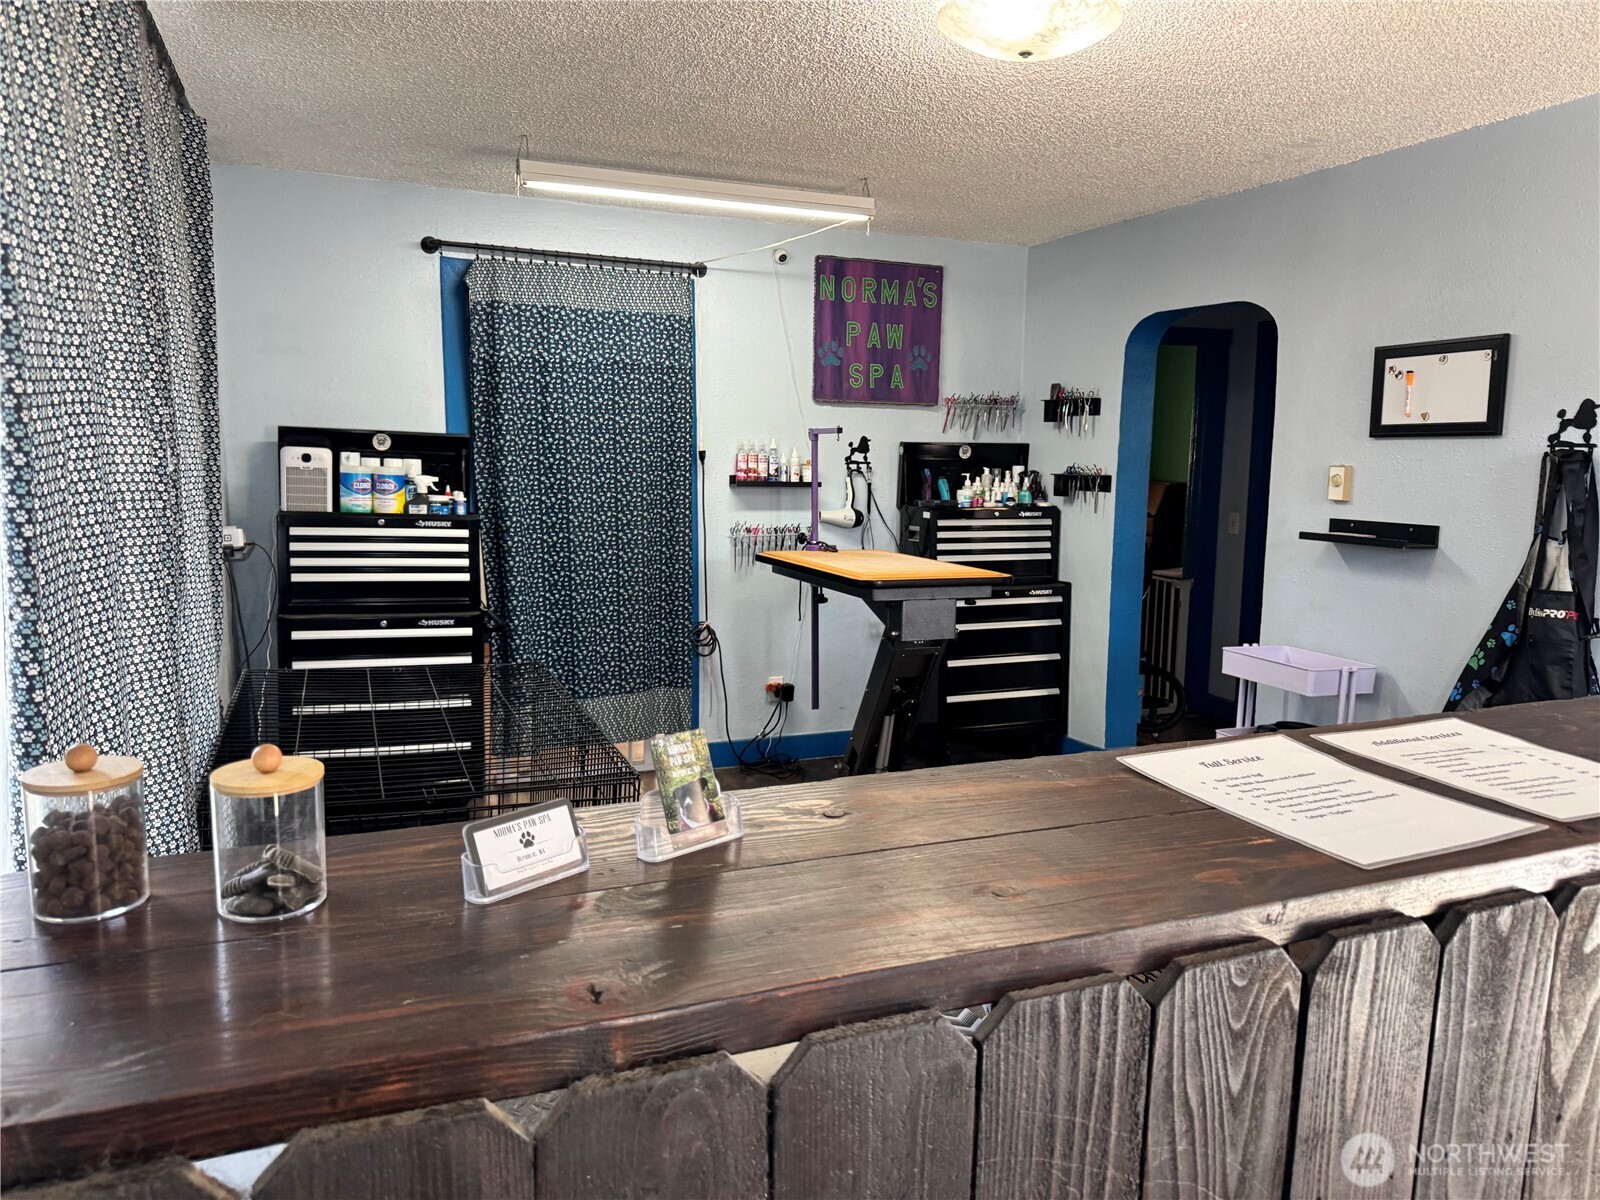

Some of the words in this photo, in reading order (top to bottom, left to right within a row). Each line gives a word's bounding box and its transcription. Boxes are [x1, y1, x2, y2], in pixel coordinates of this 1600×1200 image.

[819, 274, 938, 309] NORMA'S
[846, 320, 904, 350] PAW
[849, 363, 904, 389] SPA
[1199, 760, 1226, 769] Full
[1222, 755, 1264, 766] Service
[493, 821, 523, 839] NORMA'S
[522, 817, 538, 830] PAW
[537, 812, 552, 825] SPA
